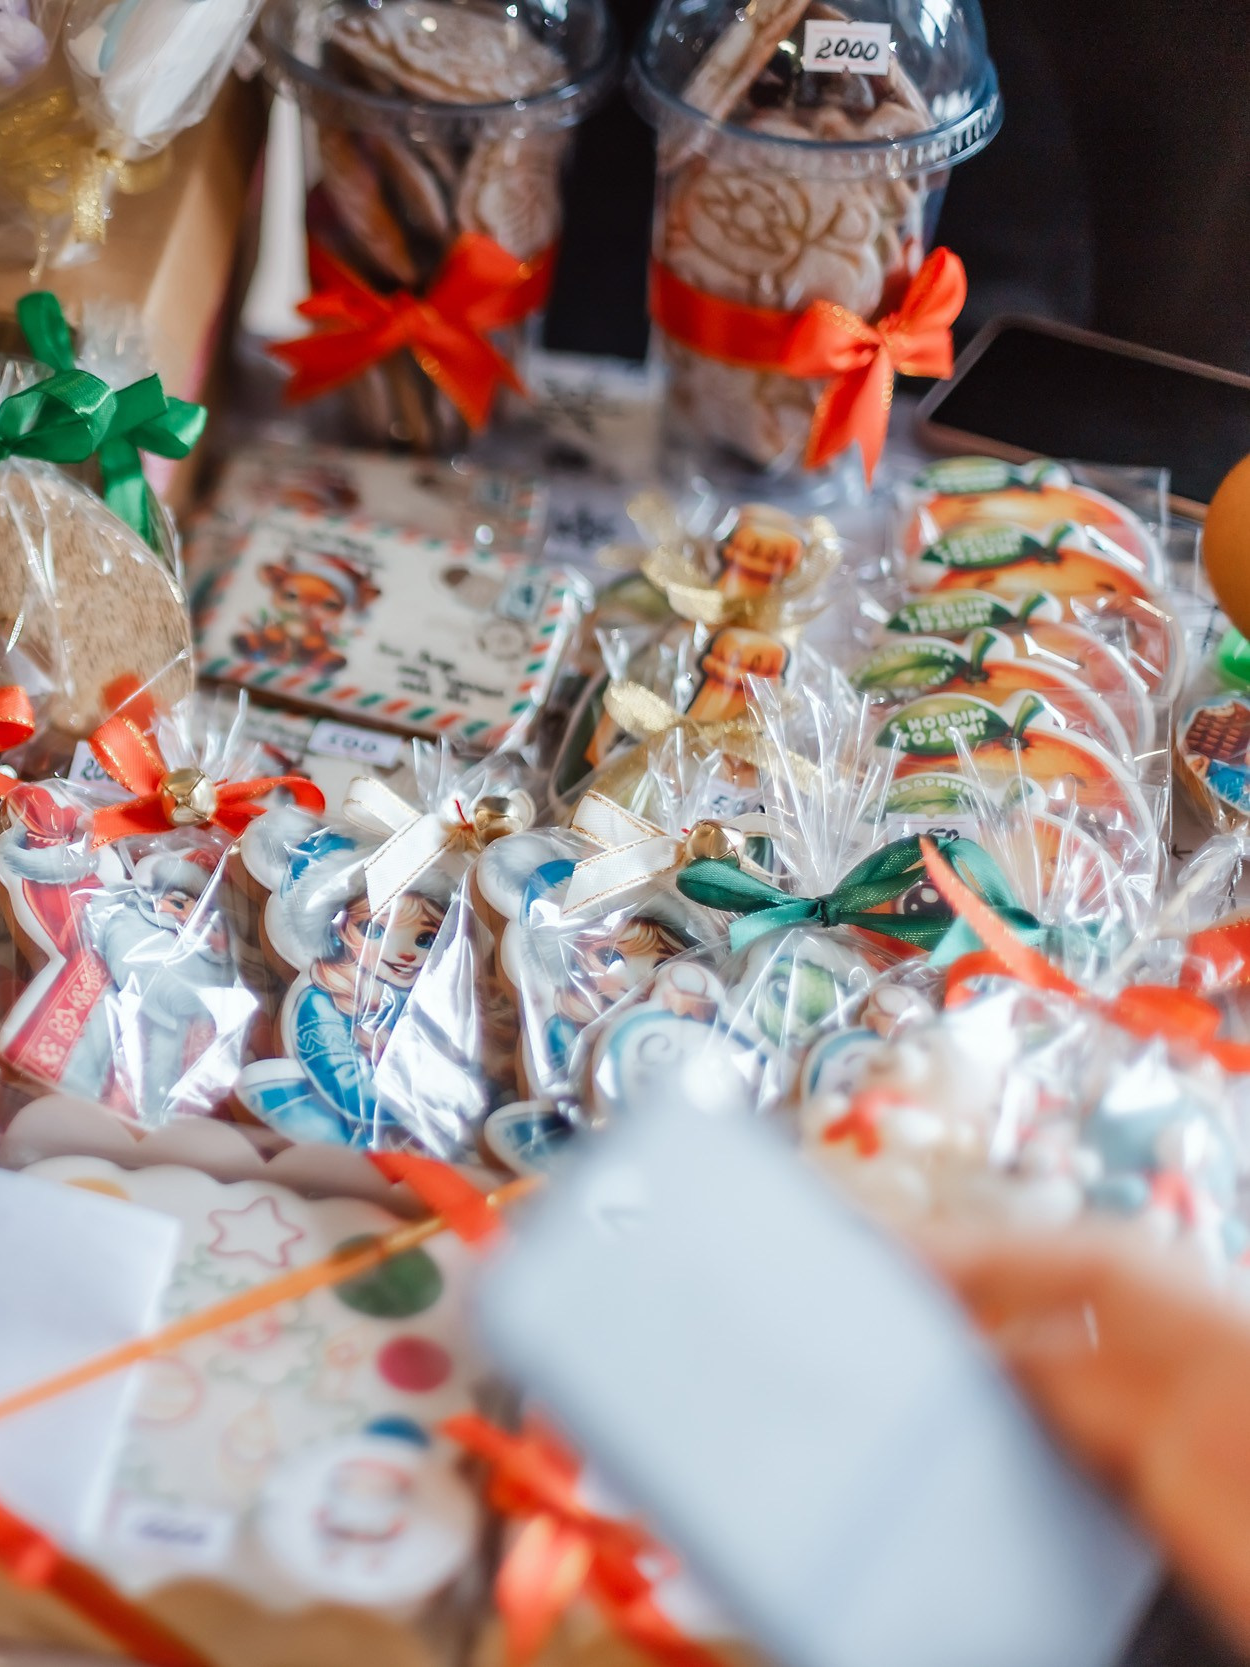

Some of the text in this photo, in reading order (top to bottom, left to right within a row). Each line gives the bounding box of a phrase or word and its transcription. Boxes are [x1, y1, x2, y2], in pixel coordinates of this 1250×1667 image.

[815, 37, 879, 61] 2000
[890, 707, 987, 735] С НОВЫМ
